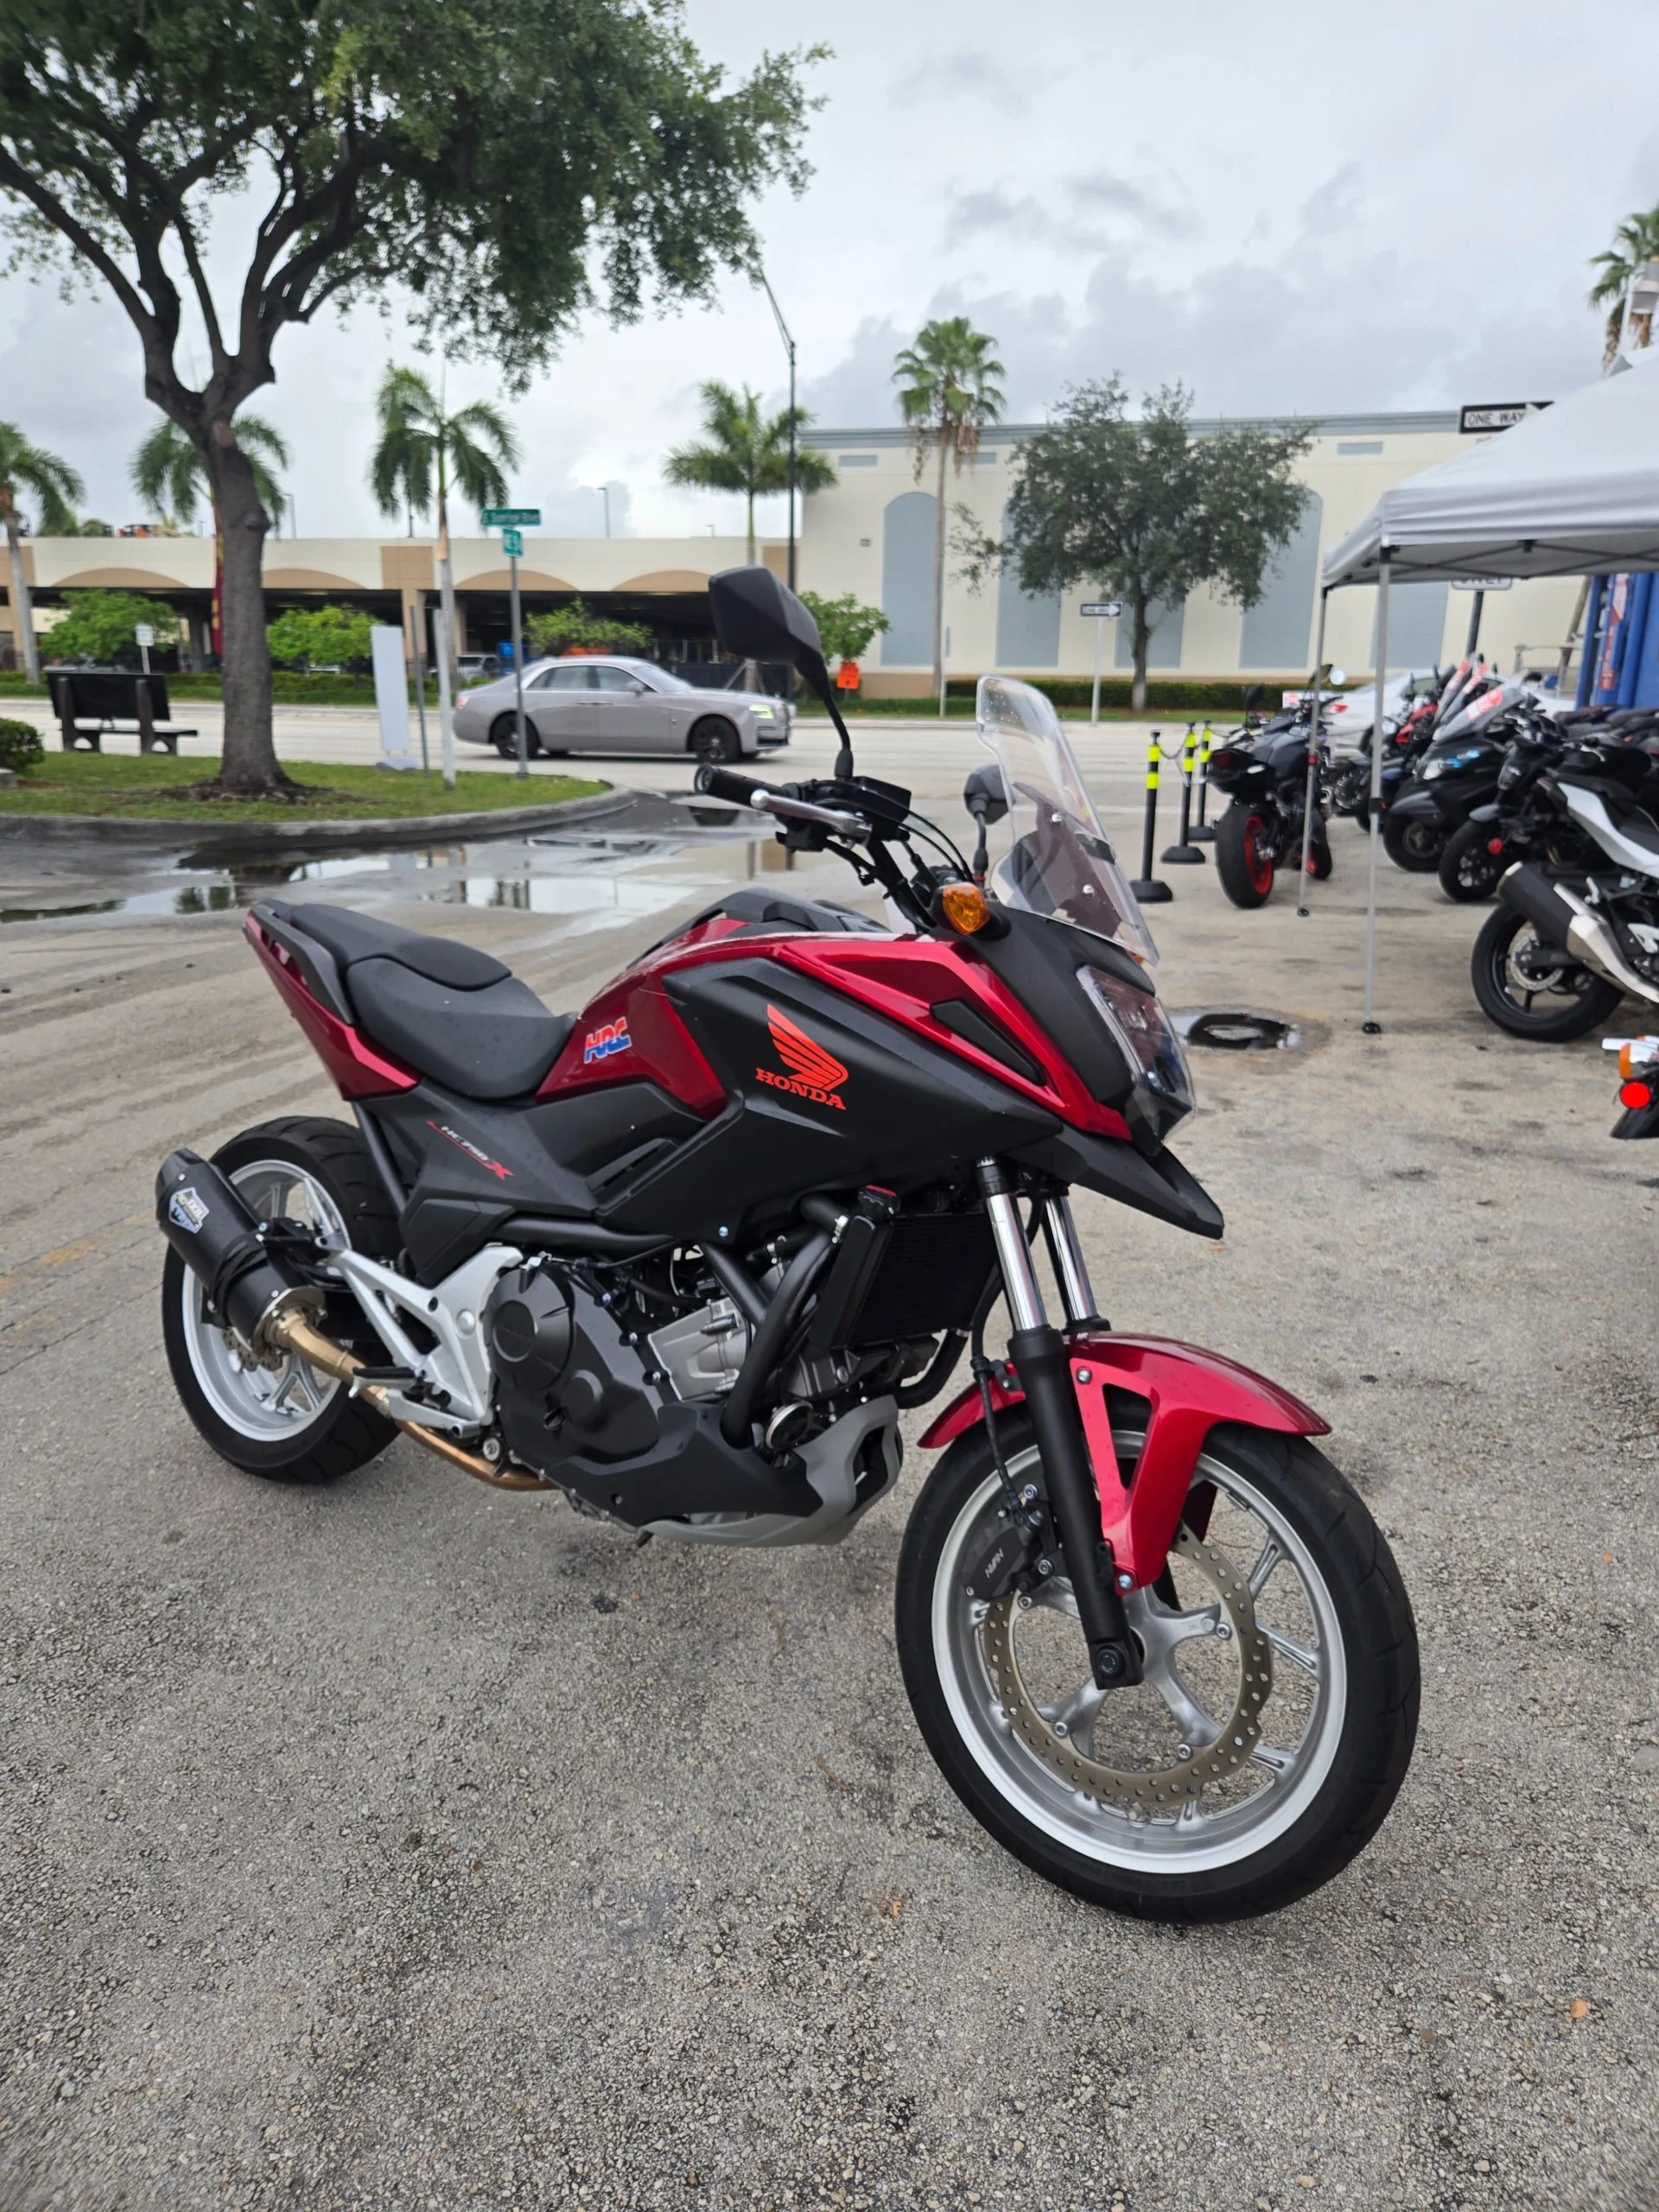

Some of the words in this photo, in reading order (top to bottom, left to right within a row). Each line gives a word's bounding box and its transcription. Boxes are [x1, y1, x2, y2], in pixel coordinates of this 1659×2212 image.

[1467, 413, 1493, 426] ONE
[583, 1016, 632, 1064] HRC
[755, 1068, 846, 1110] HONDA
